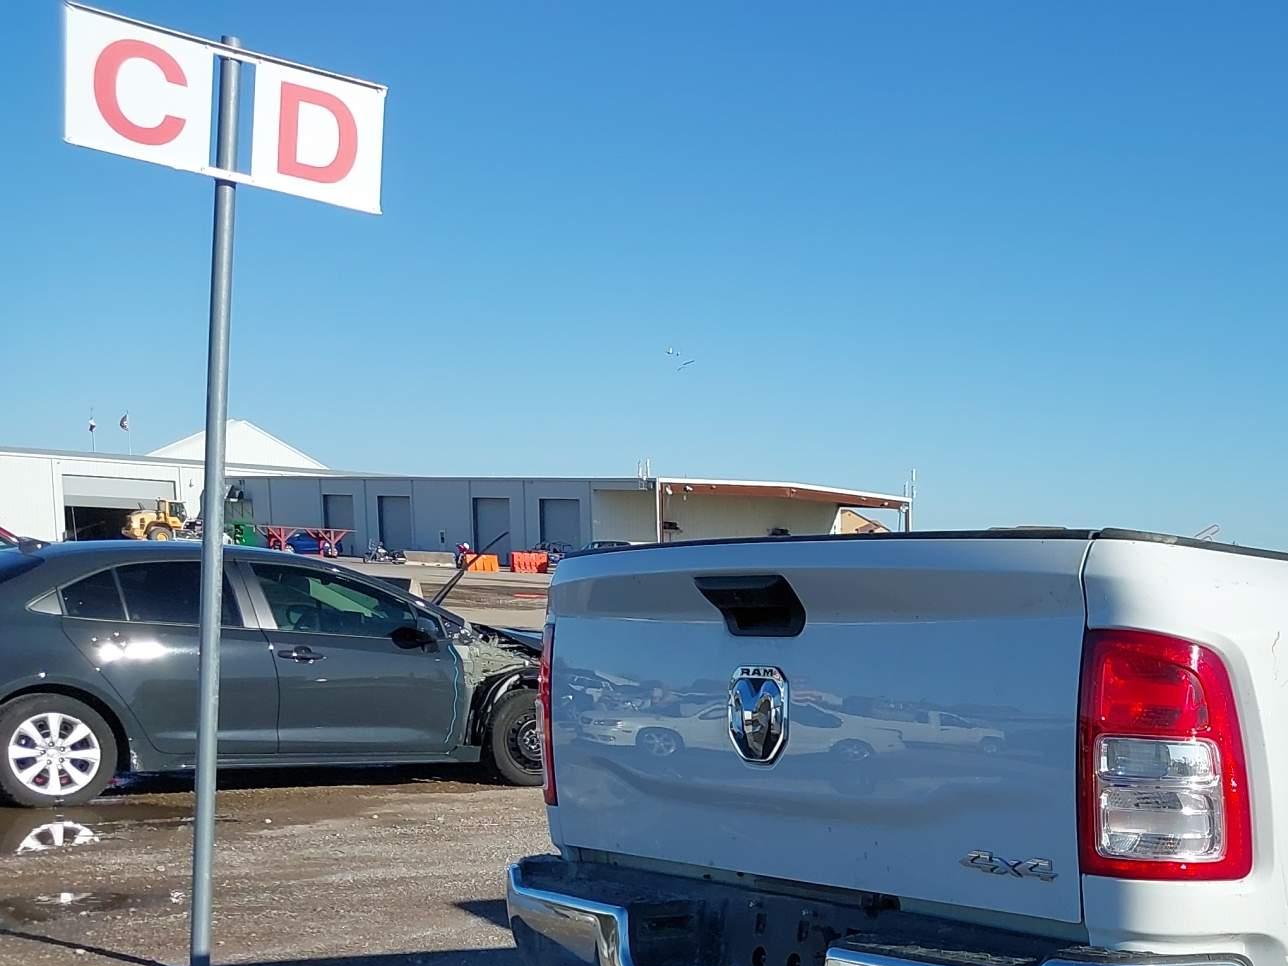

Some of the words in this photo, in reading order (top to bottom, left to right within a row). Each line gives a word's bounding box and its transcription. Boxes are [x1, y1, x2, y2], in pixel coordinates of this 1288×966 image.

[93, 38, 188, 146] C
[277, 80, 358, 184] D
[740, 667, 773, 678] RAM
